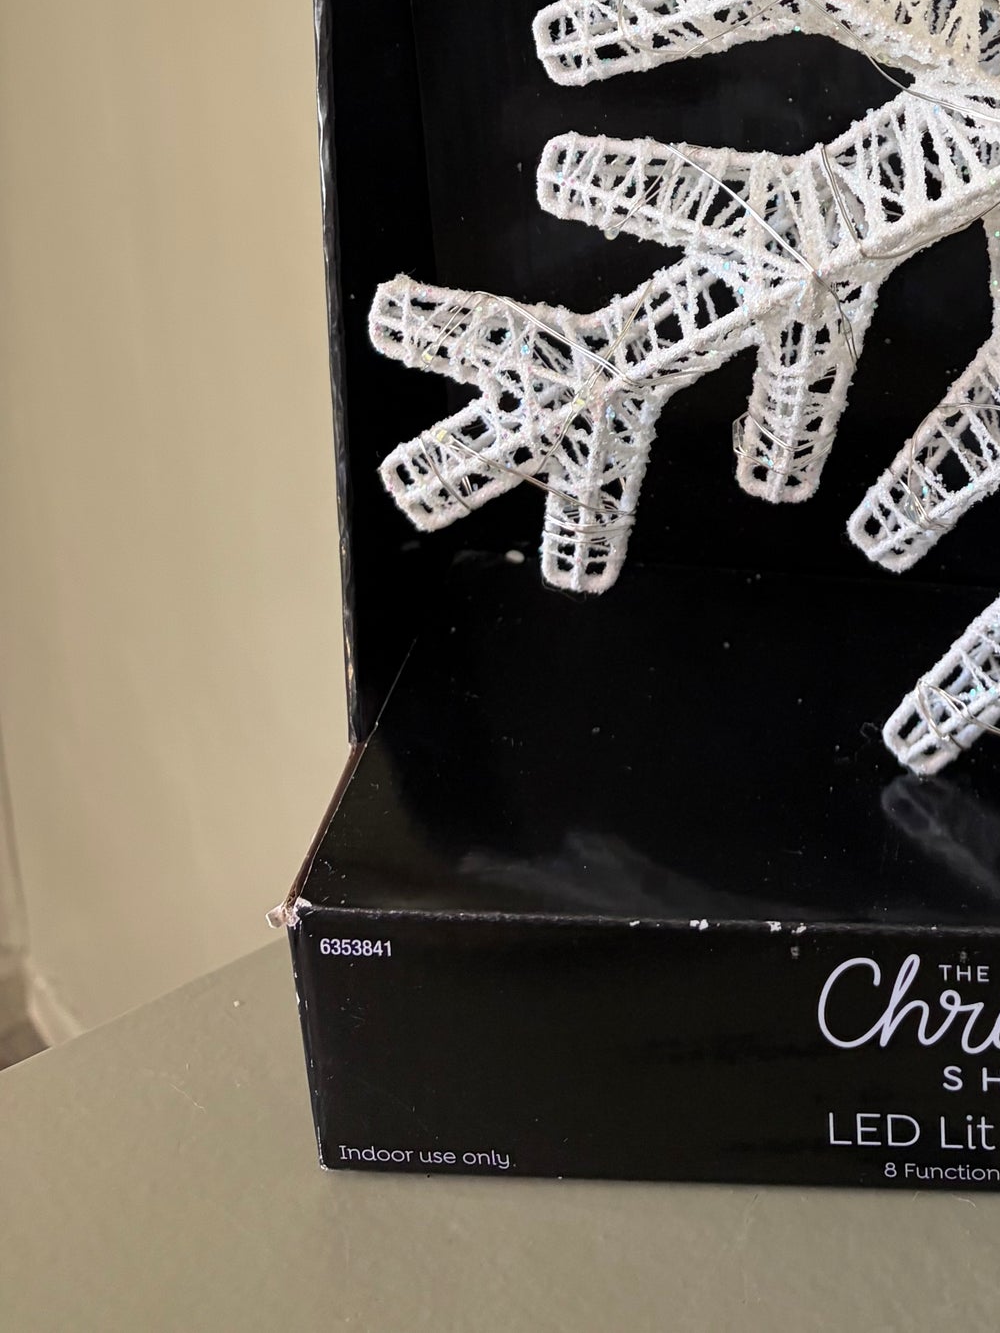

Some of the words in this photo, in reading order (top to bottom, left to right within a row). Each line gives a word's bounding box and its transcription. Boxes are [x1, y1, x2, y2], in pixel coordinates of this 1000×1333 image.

[319, 937, 392, 957] 6353841
[938, 964, 990, 983] THE
[828, 1112, 921, 1147] LED
[940, 1114, 996, 1151] Lit
[338, 1144, 414, 1163] Indoor
[419, 1150, 457, 1164] use
[884, 1162, 898, 1178] 8
[904, 1163, 1000, 1181] Function
